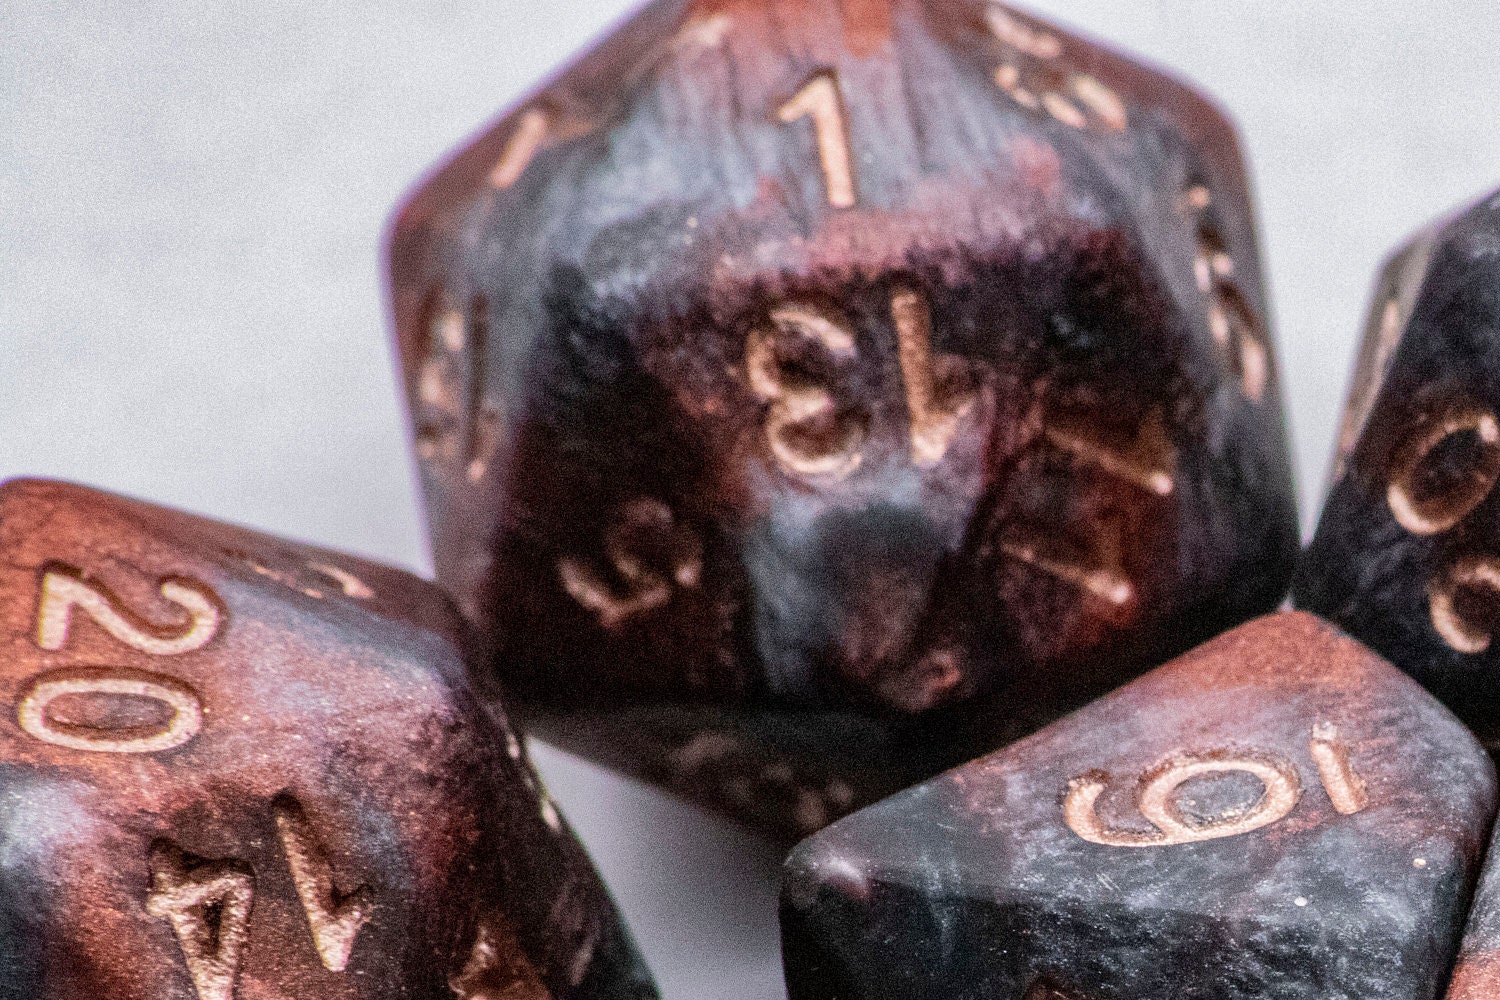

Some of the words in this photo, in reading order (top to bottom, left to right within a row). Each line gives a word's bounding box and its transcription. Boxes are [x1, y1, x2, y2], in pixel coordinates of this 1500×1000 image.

[778, 68, 856, 206] 1
[747, 285, 977, 478] 13
[18, 565, 224, 753] 20
